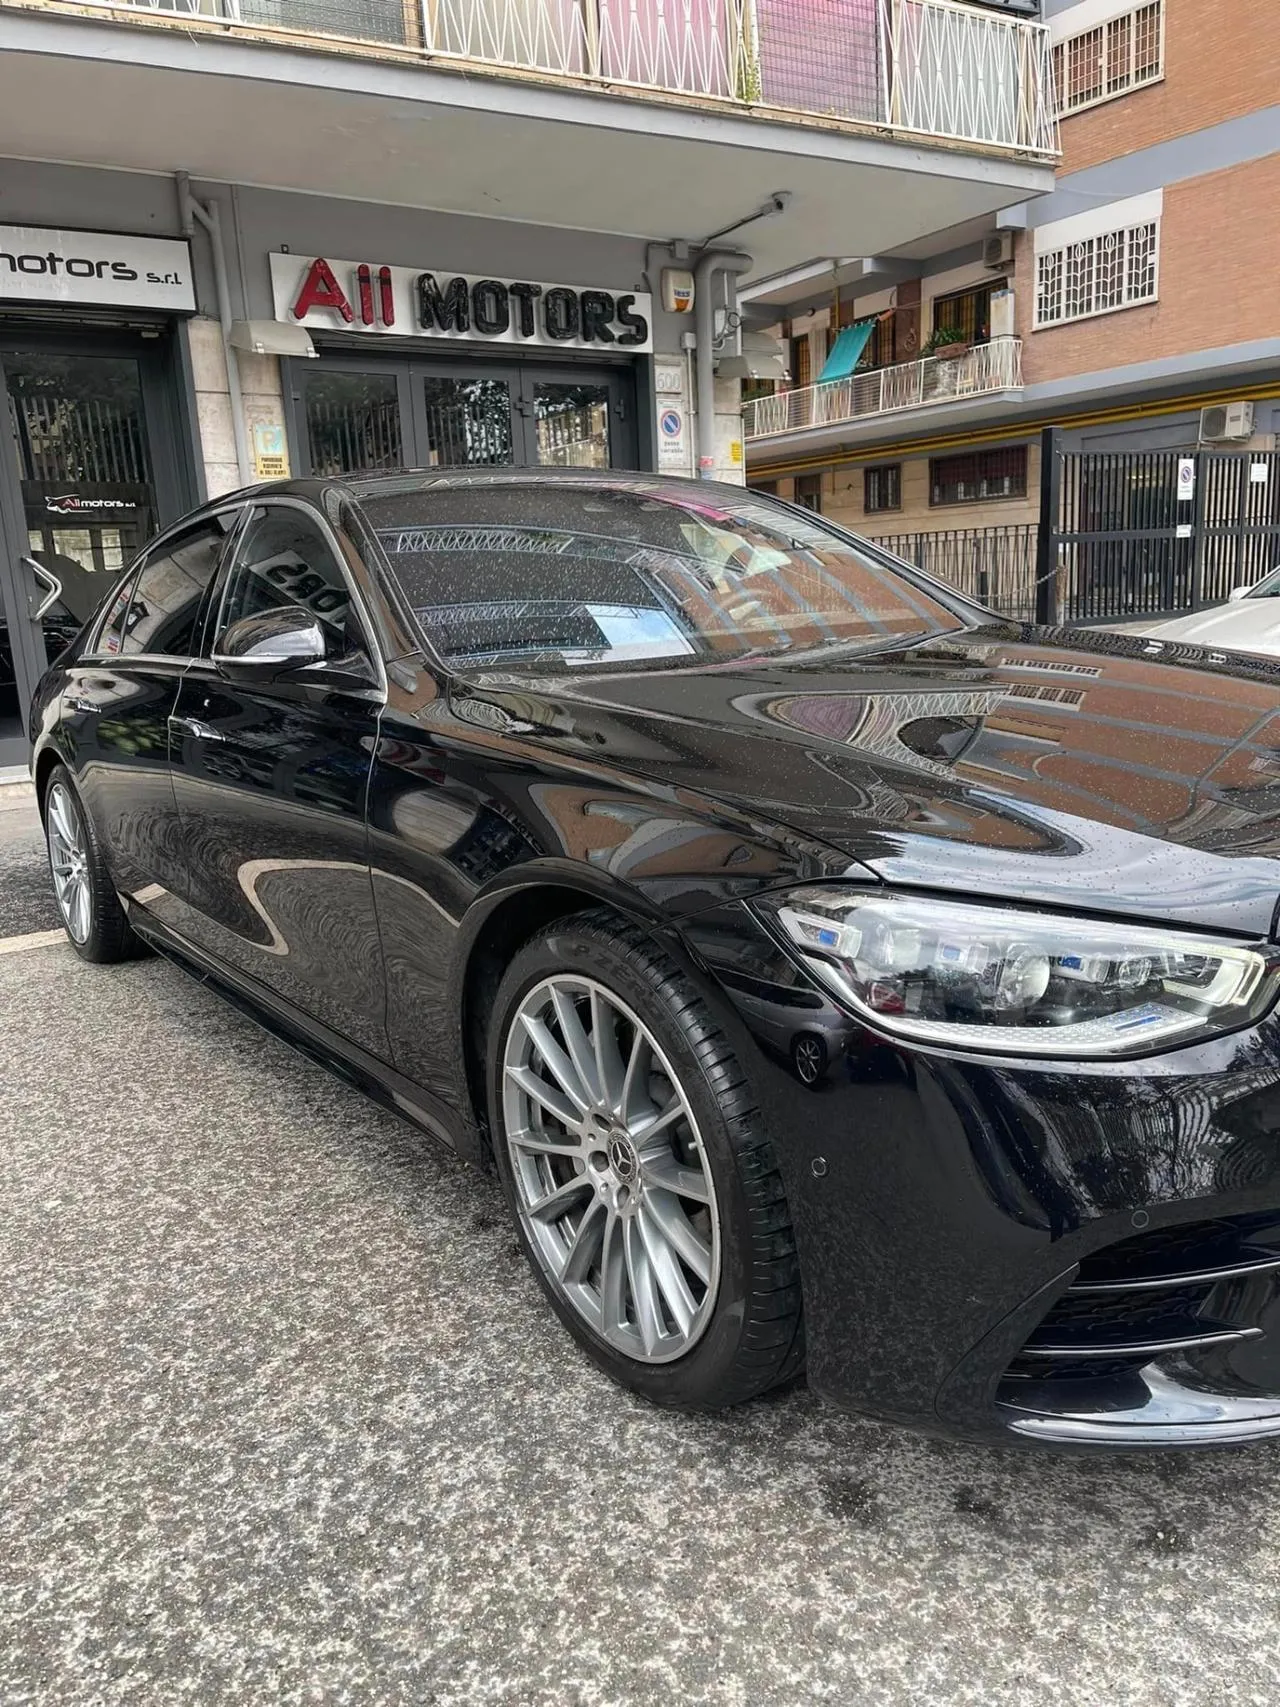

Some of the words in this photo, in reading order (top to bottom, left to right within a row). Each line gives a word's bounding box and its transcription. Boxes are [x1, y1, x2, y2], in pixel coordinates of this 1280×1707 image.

[293, 257, 395, 327] All
[417, 272, 648, 345] MOTORS
[656, 372, 681, 390] 600
